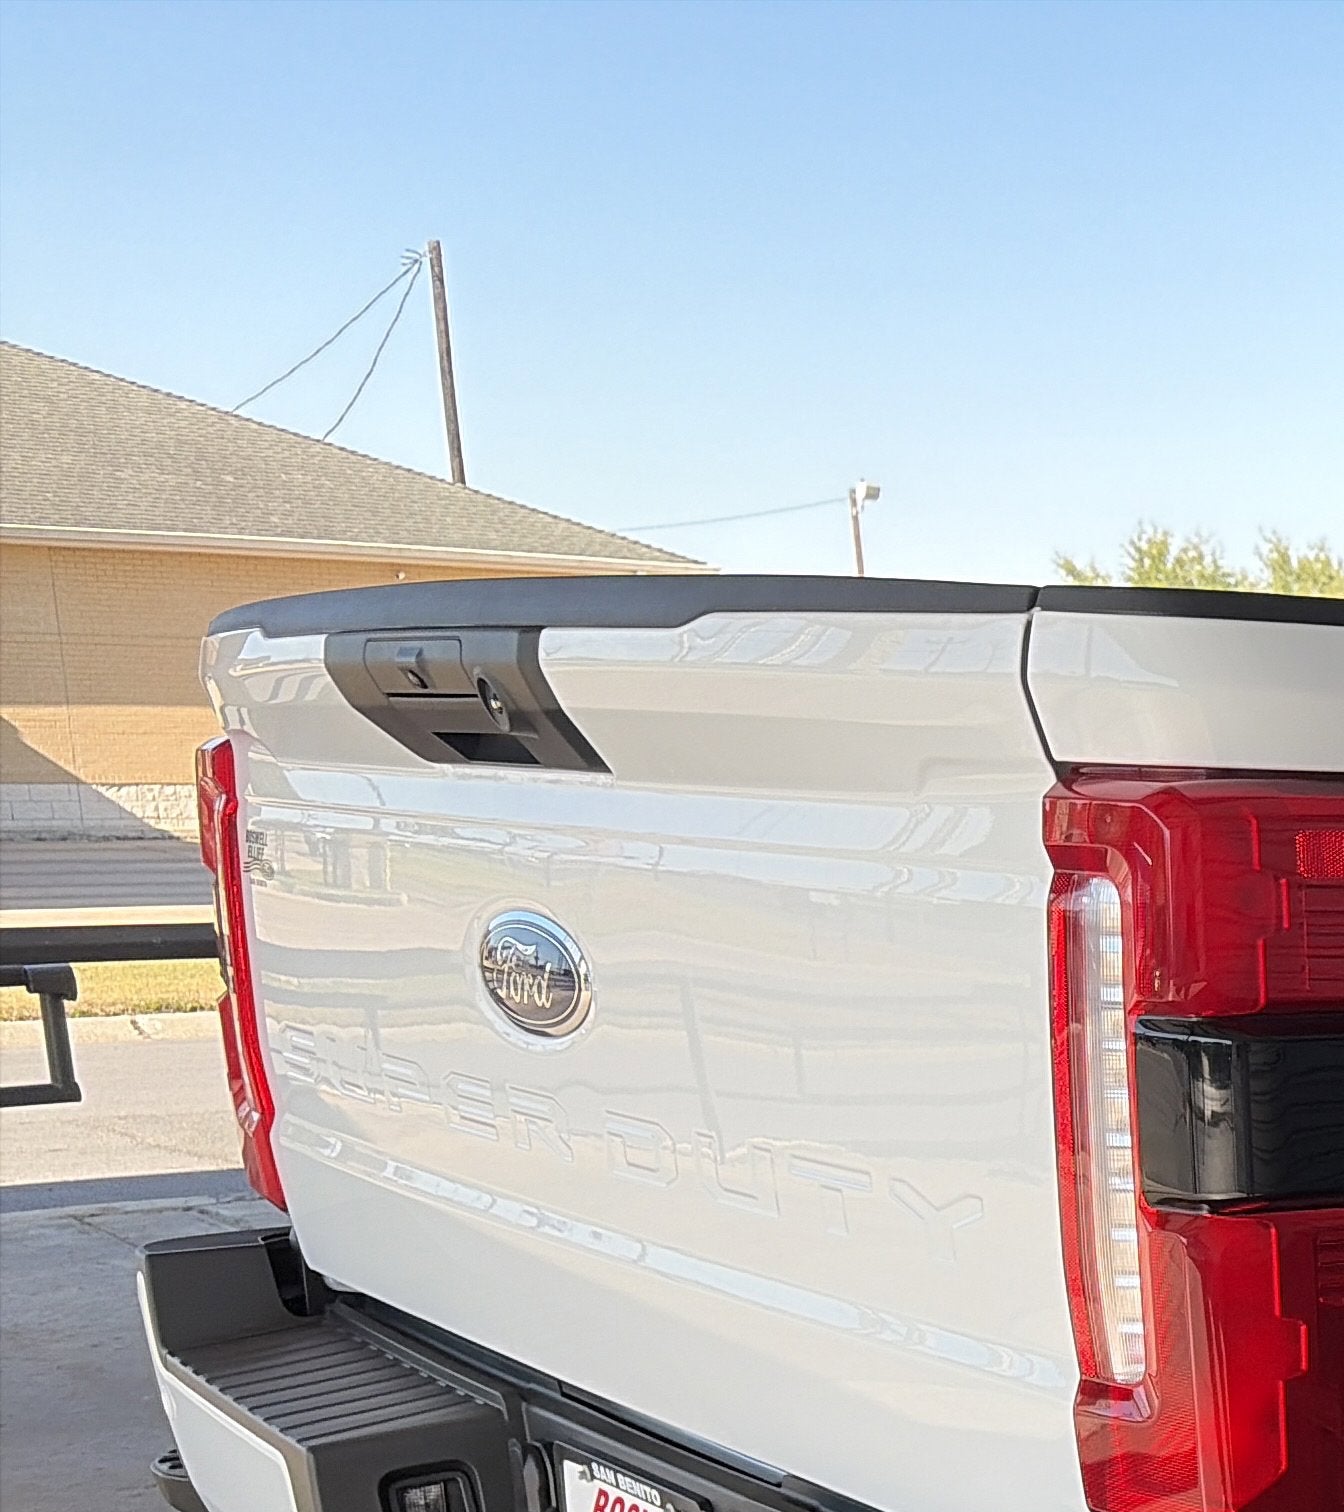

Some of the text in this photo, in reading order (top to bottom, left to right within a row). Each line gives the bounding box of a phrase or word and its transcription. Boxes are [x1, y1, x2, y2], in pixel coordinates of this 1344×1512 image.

[484, 936, 553, 1008] Ford
[276, 1020, 985, 1262] SUPER DUTY
[590, 1461, 662, 1507] SAN BENITO
